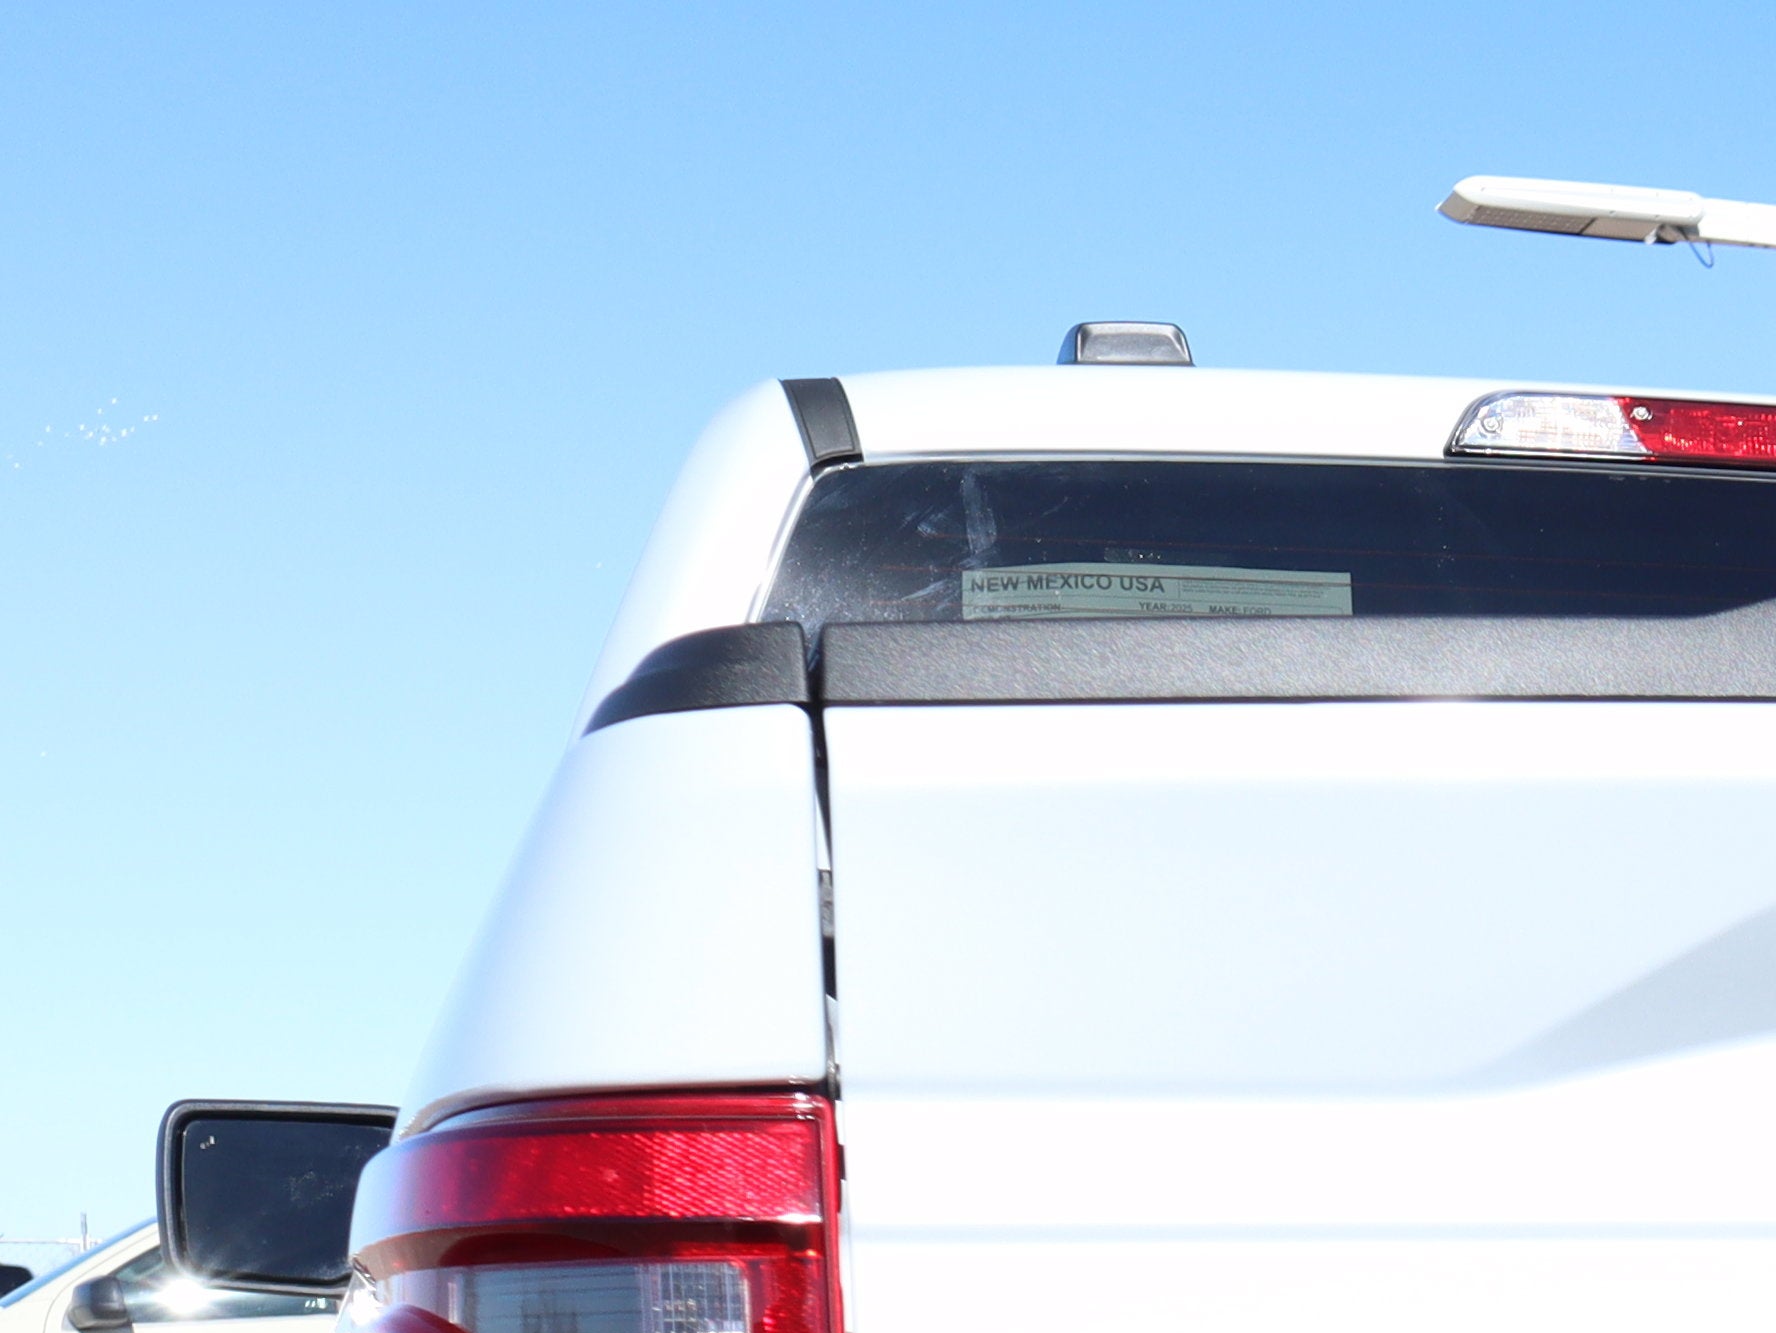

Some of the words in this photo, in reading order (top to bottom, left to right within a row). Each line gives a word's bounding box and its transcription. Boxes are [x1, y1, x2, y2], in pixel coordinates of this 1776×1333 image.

[971, 575, 1019, 593] NEW
[1026, 574, 1114, 592] MEXICO
[1119, 575, 1165, 594] USA
[1243, 606, 1272, 616] FORD
